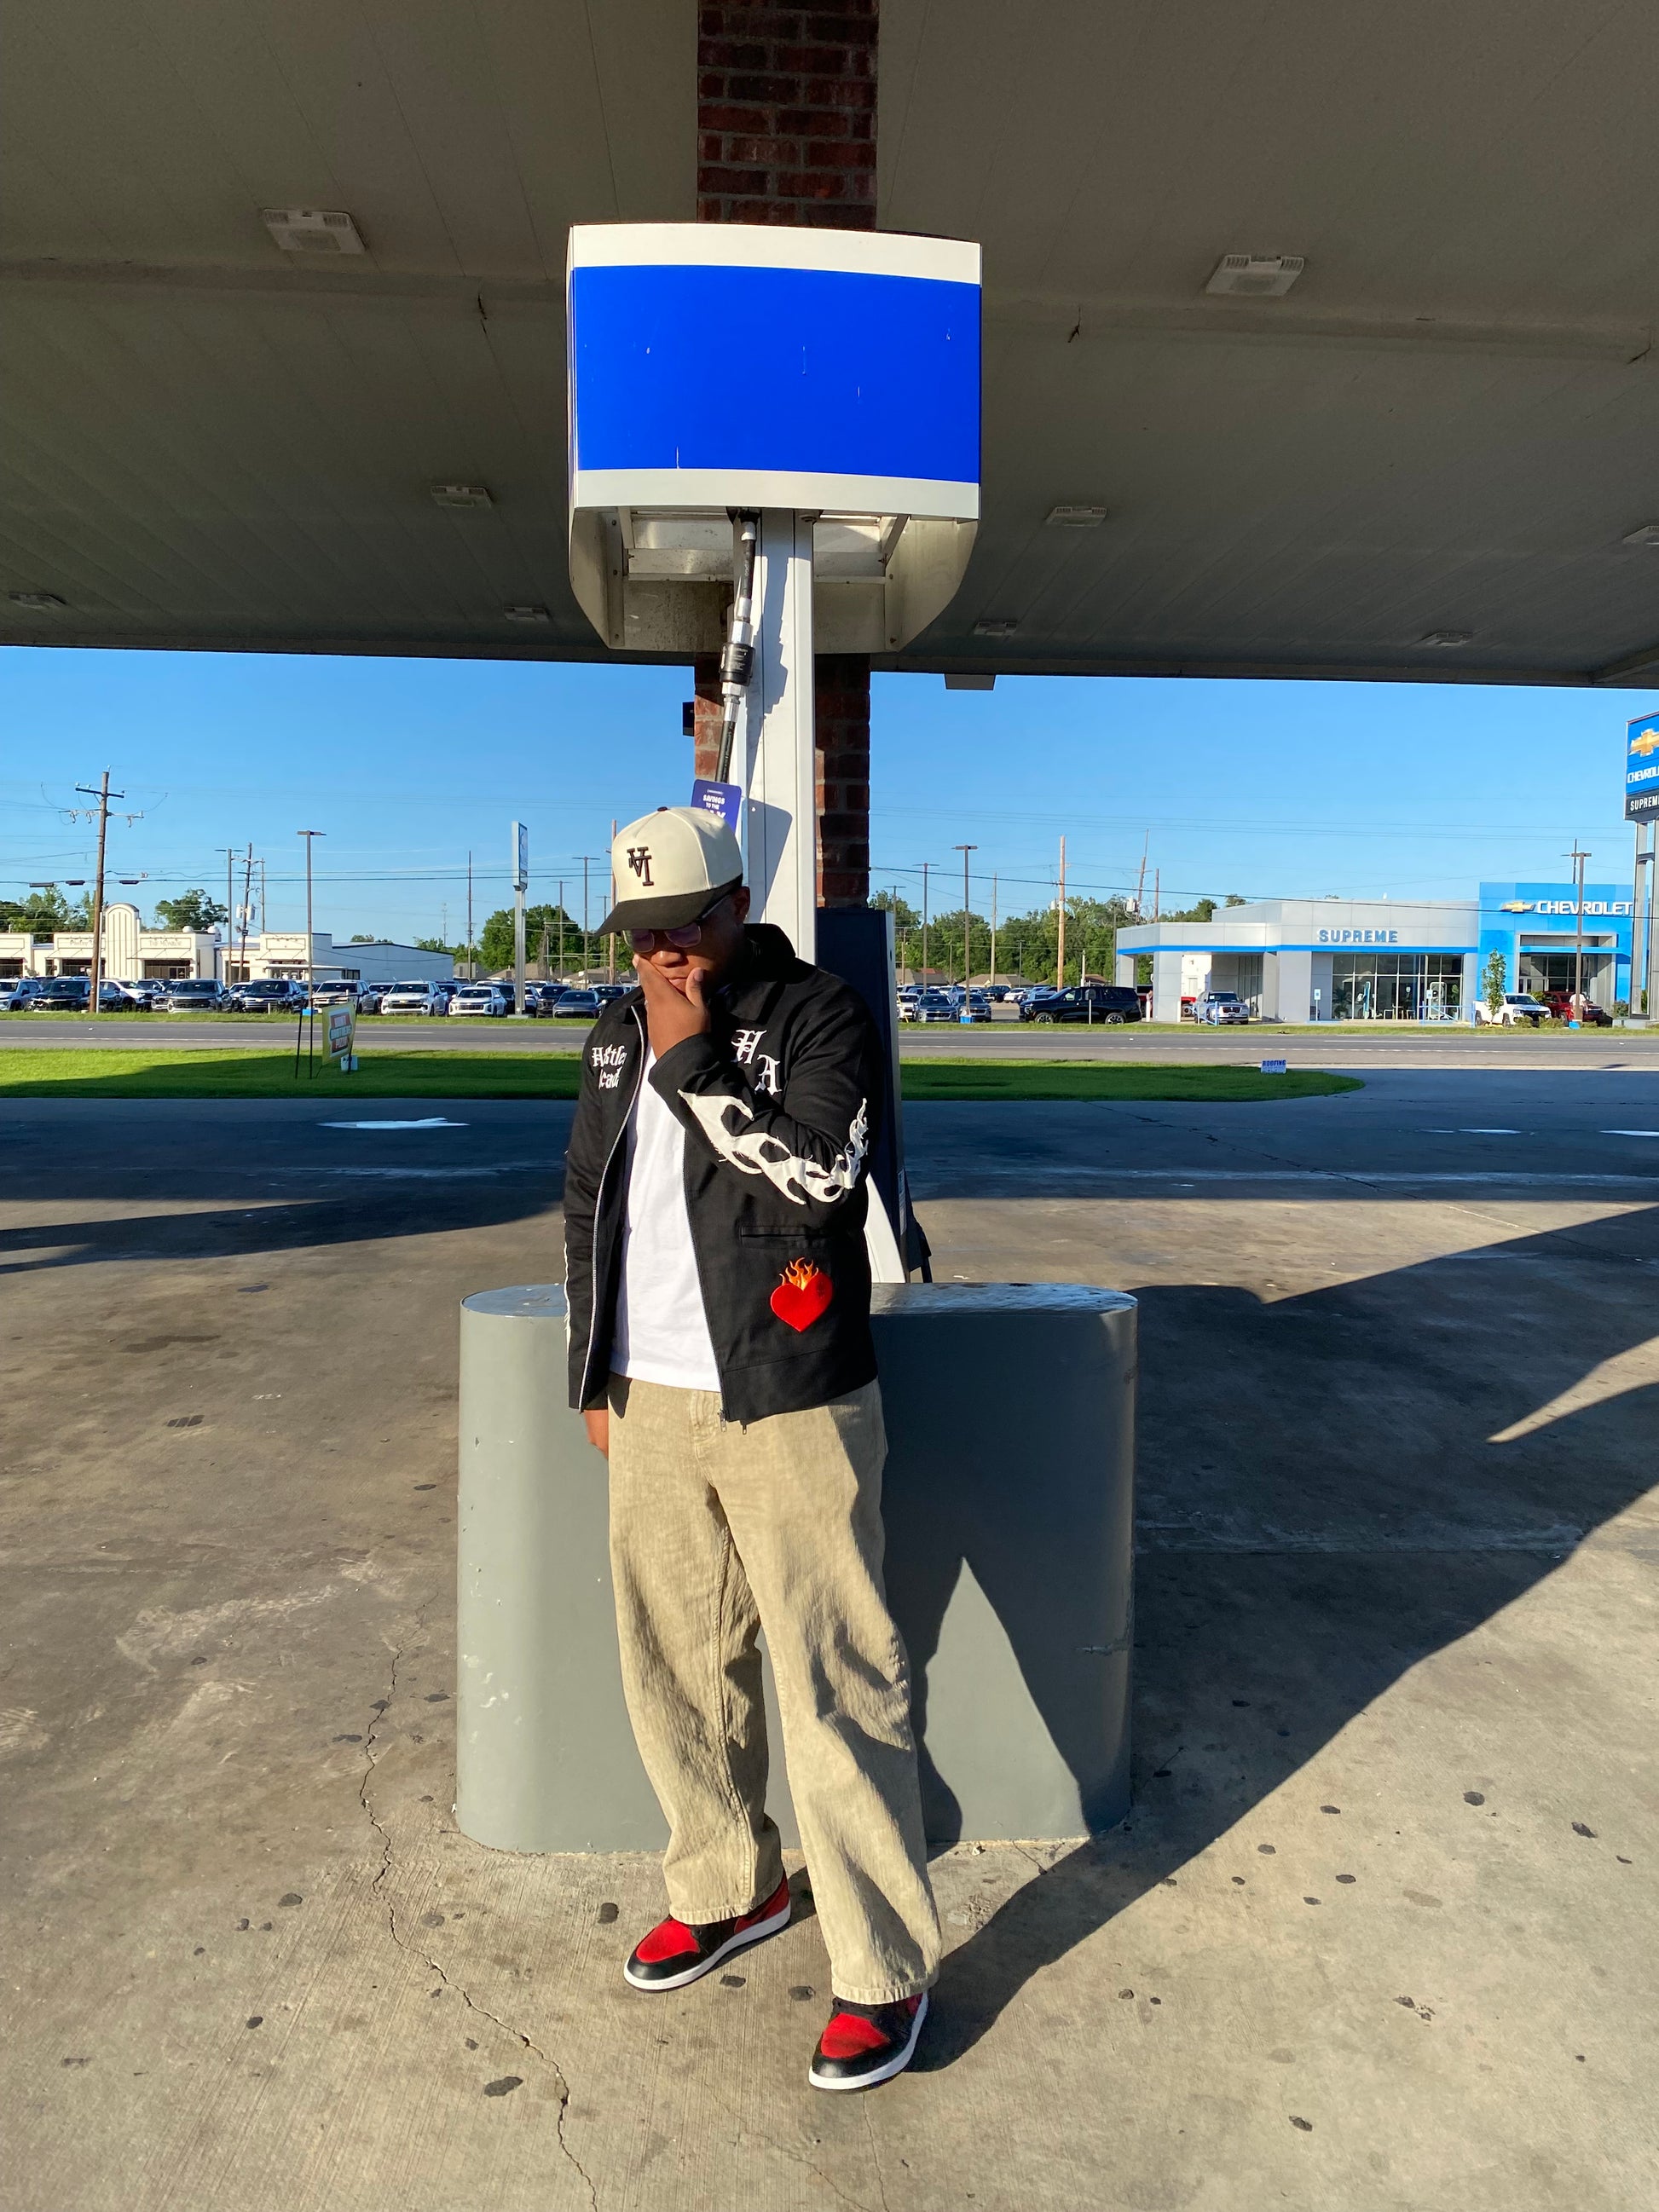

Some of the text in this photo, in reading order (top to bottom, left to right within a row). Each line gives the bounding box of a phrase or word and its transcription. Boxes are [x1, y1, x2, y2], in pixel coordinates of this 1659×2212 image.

[1627, 765, 1659, 783] CHEVROL
[702, 794, 725, 805] SAVINGS
[1630, 795, 1659, 811] SUPREM
[1537, 900, 1633, 915] CHEVROLET
[1319, 929, 1398, 943] SUPREME
